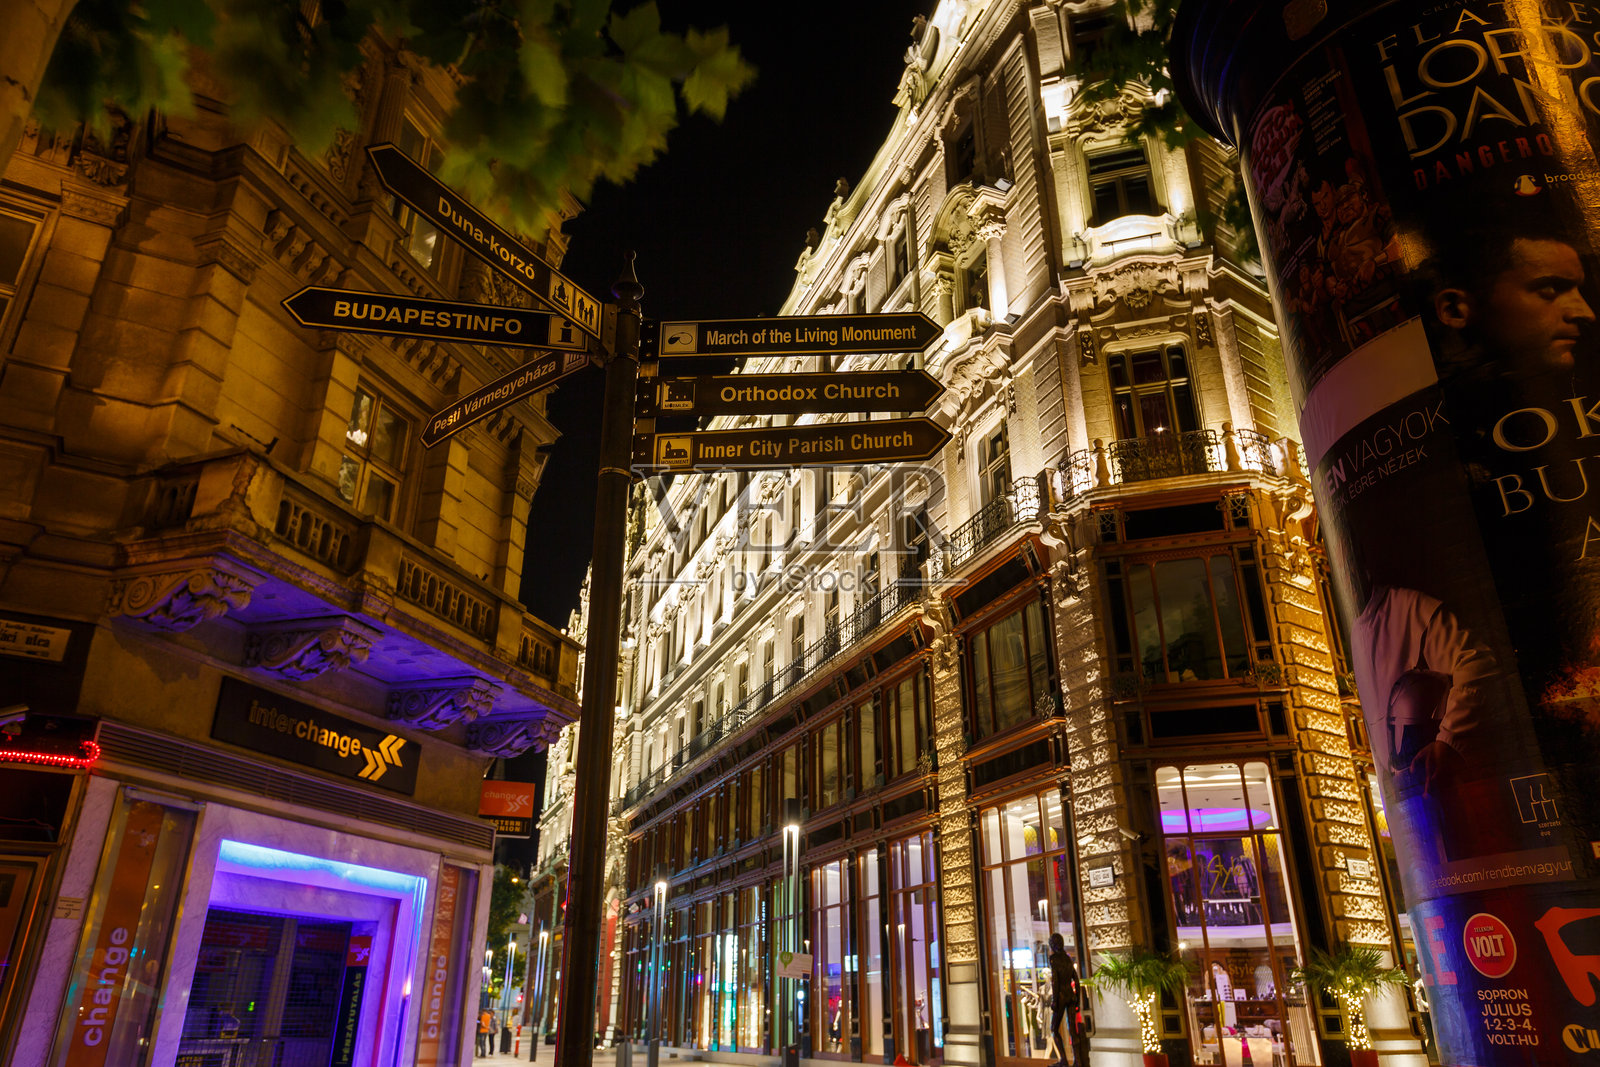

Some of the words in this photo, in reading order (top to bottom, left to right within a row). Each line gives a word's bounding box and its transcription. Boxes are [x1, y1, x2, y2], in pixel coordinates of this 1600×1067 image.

[1376, 1, 1600, 63] FLATLE
[1383, 25, 1600, 111] LORD
[438, 196, 536, 280] Duna-korzó
[333, 300, 523, 335] BUDAPESTINFO
[706, 329, 749, 345] March
[752, 328, 767, 344] of
[769, 328, 792, 343] the
[795, 327, 838, 346] Living
[842, 325, 917, 342] Monument
[433, 410, 461, 435] Pesti
[464, 360, 557, 417] Vármegyeháza
[720, 384, 818, 402] Orthodox
[824, 382, 900, 399] Church
[699, 443, 743, 459] Inner
[750, 440, 782, 460] City
[789, 437, 844, 454] Parish
[850, 431, 913, 450] Church
[1345, 400, 1450, 472] VAGYOK
[1378, 445, 1428, 479] NÉZEK
[1491, 455, 1600, 517] BU
[249, 701, 361, 758] interchange
[484, 791, 517, 801] change
[1207, 854, 1246, 895] Style
[1430, 860, 1572, 889] acebook.com/rendbenvagyu
[1470, 934, 1505, 958] VOLT
[83, 926, 128, 1047] change
[427, 955, 447, 1039] change
[1477, 989, 1529, 1001] SOPRON
[1482, 1000, 1532, 1017] JÚLIUS
[1484, 1018, 1537, 1031] 1-2-3-4.
[1486, 1034, 1539, 1046] VOLT.HU
